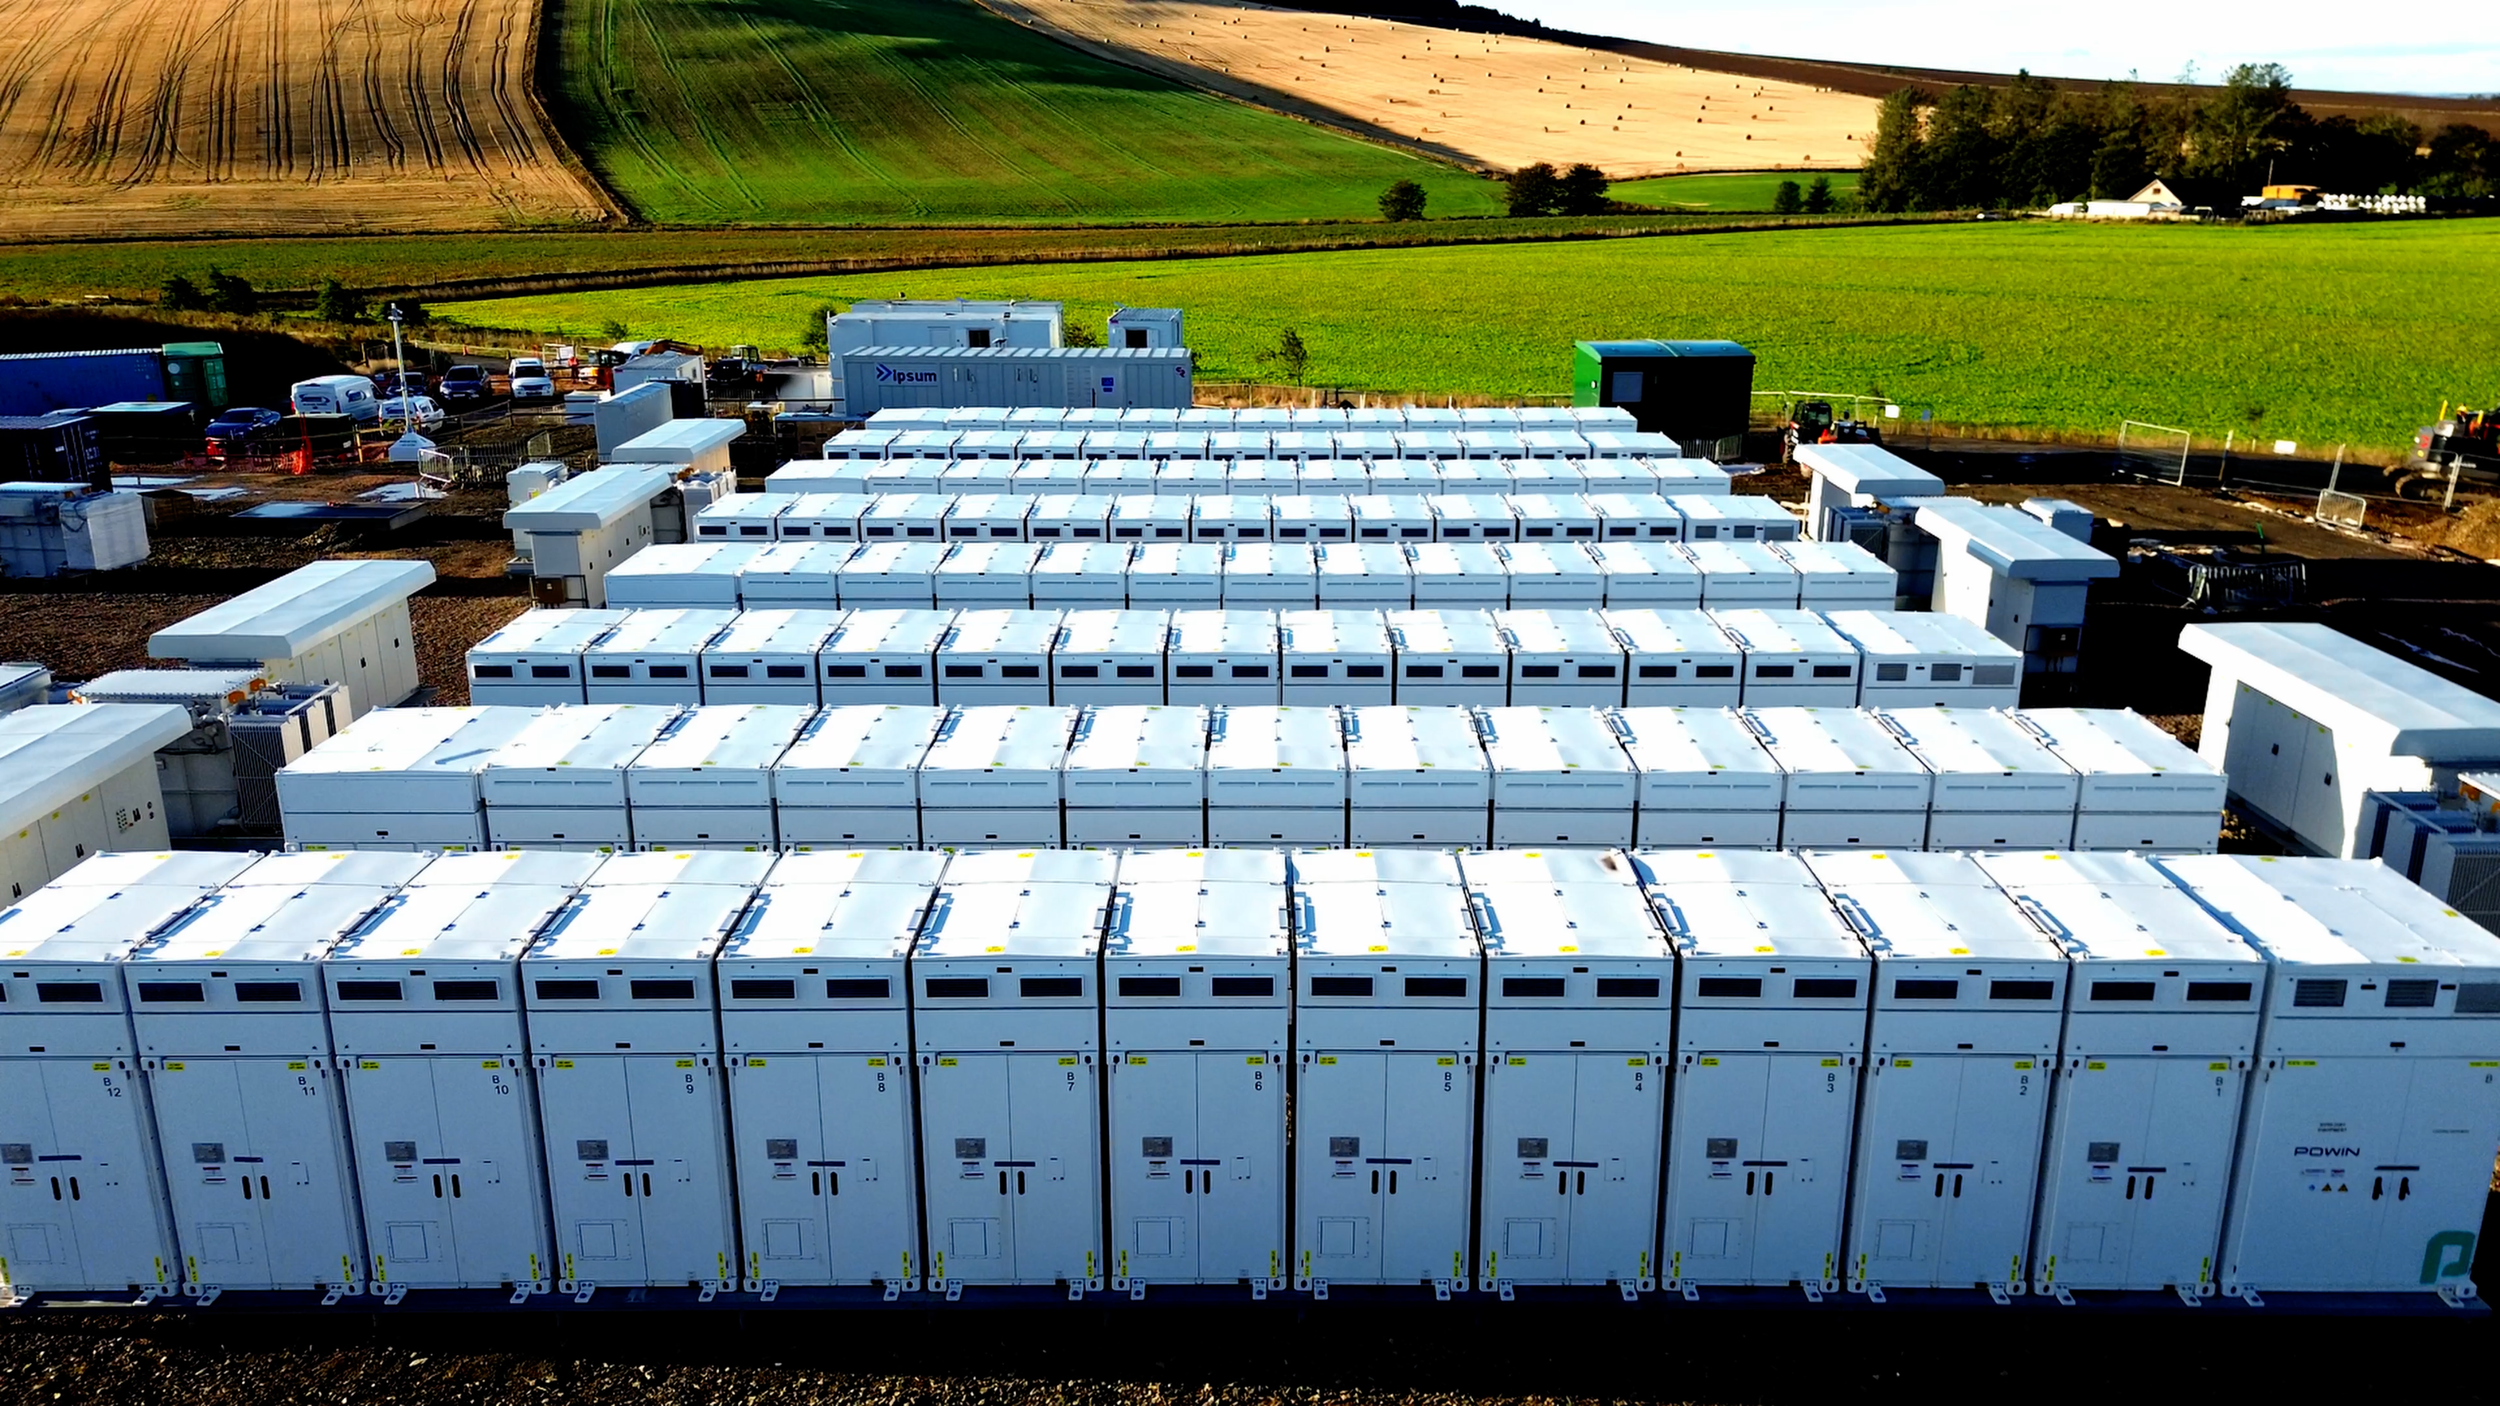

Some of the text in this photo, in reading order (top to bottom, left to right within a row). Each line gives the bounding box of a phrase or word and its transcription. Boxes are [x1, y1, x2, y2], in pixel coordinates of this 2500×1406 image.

[492, 1074, 500, 1084] B
[685, 1073, 693, 1083] B
[877, 1072, 885, 1082] B
[1067, 1071, 1075, 1081] B
[1254, 1070, 1263, 1080] B
[1444, 1071, 1452, 1081] B
[1635, 1072, 1643, 1082] B
[1827, 1072, 1835, 1082] B
[2020, 1075, 2029, 1085] B
[103, 1077, 112, 1087] B
[297, 1076, 307, 1086] B
[1067, 1081, 1075, 1091] 7
[1254, 1080, 1263, 1091] 6
[302, 1086, 316, 1096] 11
[495, 1084, 509, 1095] 10
[685, 1084, 694, 1094] 9
[878, 1082, 886, 1093] 8
[1444, 1081, 1452, 1092] 5
[1635, 1082, 1643, 1092] 4
[1827, 1083, 1835, 1093] 3
[2019, 1085, 2028, 1096] 2
[107, 1087, 122, 1098] 12
[2294, 1147, 2360, 1157] POWIN
